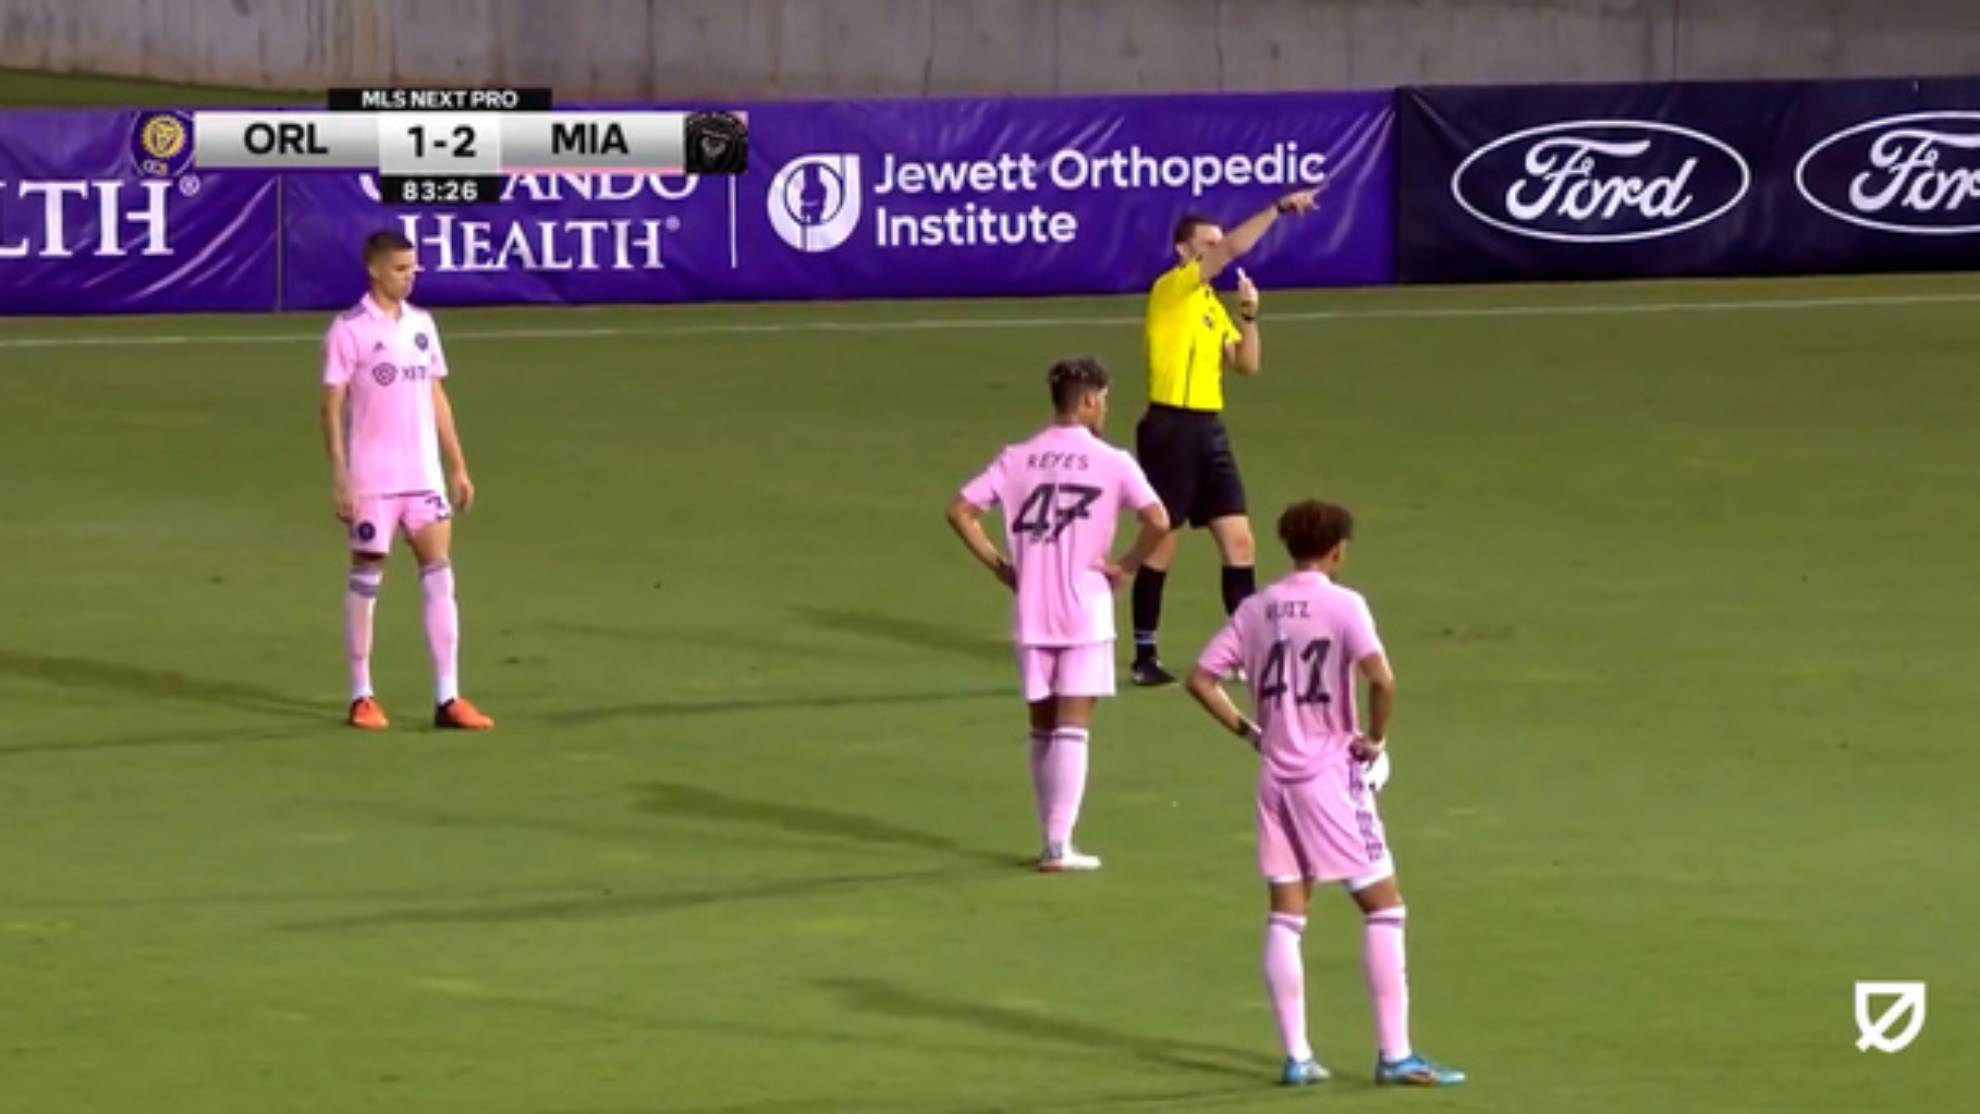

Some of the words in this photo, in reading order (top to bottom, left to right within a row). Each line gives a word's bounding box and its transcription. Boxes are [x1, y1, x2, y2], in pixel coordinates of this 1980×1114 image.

[874, 153, 1037, 195] Jewett
[1049, 141, 1326, 196] Orthopedic
[1505, 136, 1697, 221] Ford
[876, 206, 1077, 247] Institute
[1026, 452, 1089, 470] REYES
[1012, 482, 1103, 541] 47
[1259, 637, 1331, 710] 41
